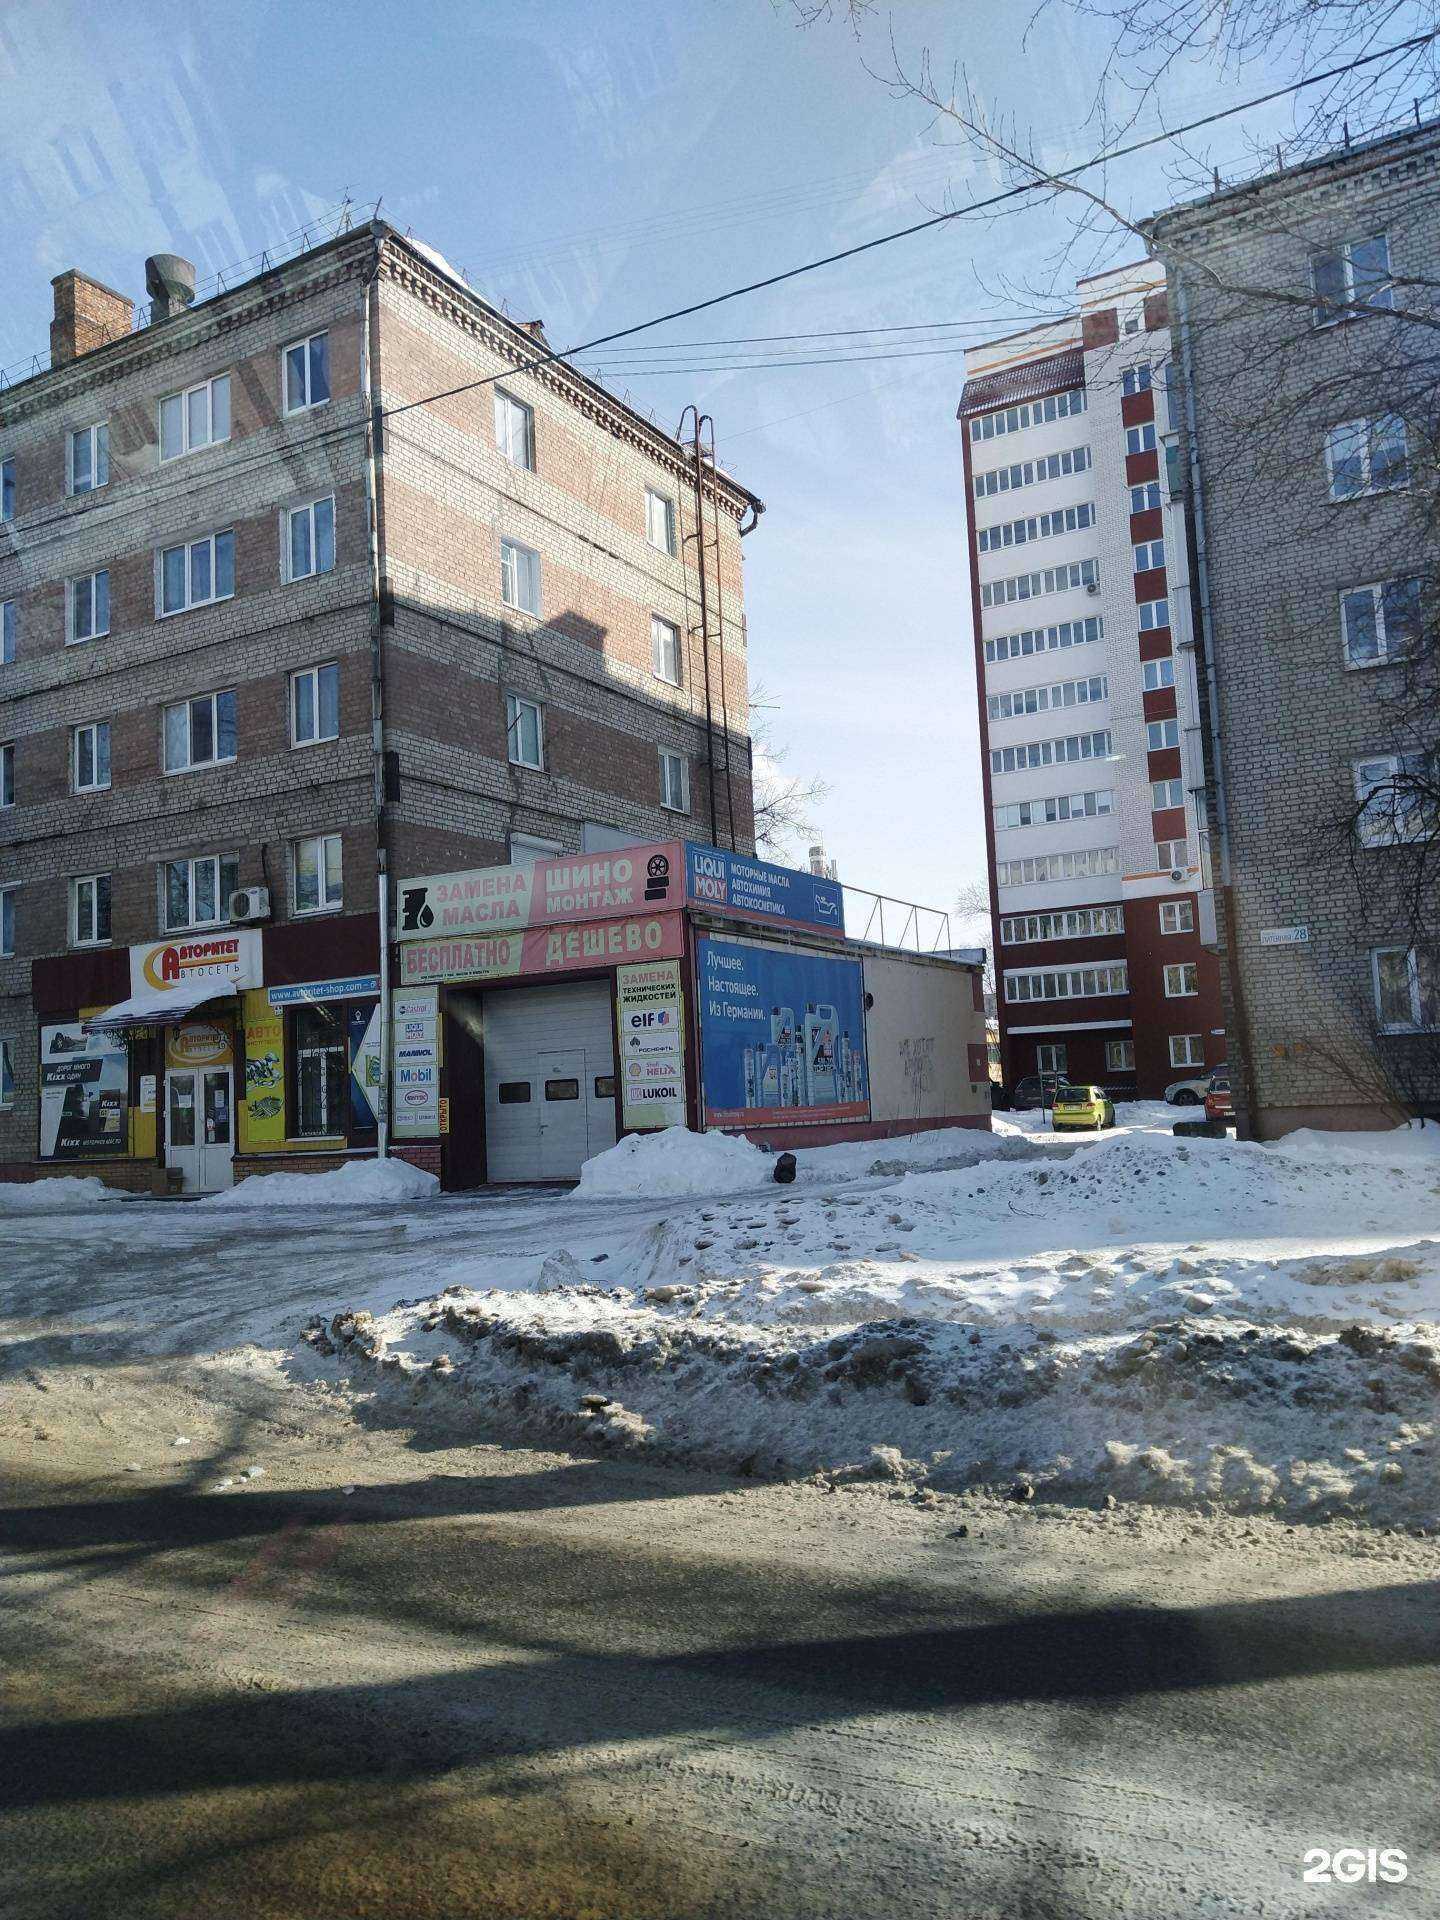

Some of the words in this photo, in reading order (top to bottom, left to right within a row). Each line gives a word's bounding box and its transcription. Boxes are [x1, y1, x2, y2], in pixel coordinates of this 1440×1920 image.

[546, 859, 633, 892] ШИНО
[694, 854, 725, 879] LIQUI
[731, 862, 767, 882] МОТОРНЫЕ
[768, 873, 790, 888] МАСЛА
[436, 873, 527, 901] ЗАМЕНА
[695, 876, 726, 899] MOLY
[732, 878, 771, 897] АВТОХИМИЯ
[546, 887, 634, 914] МОНТАЖ
[732, 894, 786, 915] АВТОКОСМЕТИКА
[442, 900, 520, 927] МАСЛА
[1295, 929, 1307, 940] 28
[545, 922, 663, 968] ДЕШЕВО
[406, 939, 511, 974] БЕСПЛАТНО
[622, 970, 673, 984] ЗАМЕНА
[623, 983, 676, 993] ТЕХНИЧЕСКИХ
[623, 991, 676, 1003] ЖИДКОСТЕЙ
[631, 1012, 654, 1028] elf
[709, 1000, 721, 1017] Из
[722, 1001, 766, 1021] Германии.
[247, 1026, 280, 1039] АВТО
[399, 1049, 432, 1057] MANNOL
[46, 1072, 66, 1081] Kixx
[401, 1068, 432, 1082] Mobil
[642, 1087, 677, 1099] LUKOIL
[440, 1099, 448, 1133] ОТКРЫТО
[61, 1138, 80, 1147] Kixx
